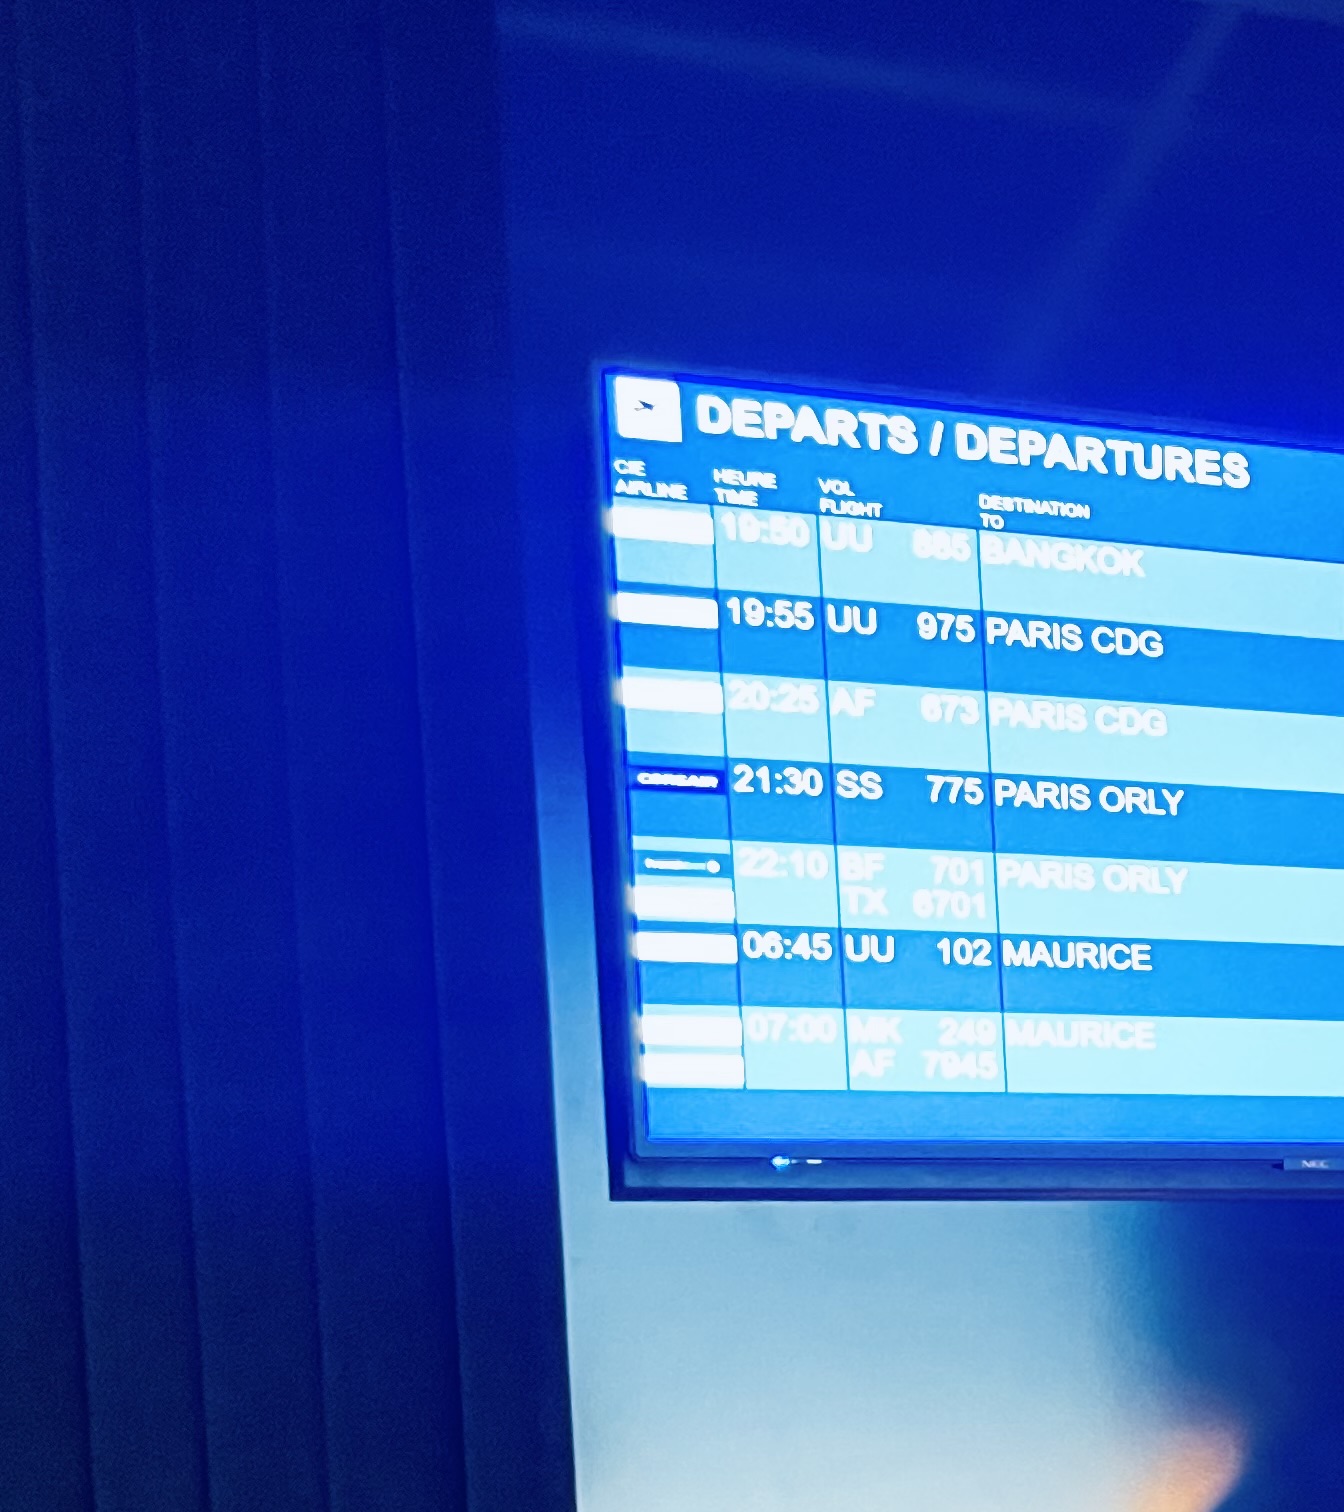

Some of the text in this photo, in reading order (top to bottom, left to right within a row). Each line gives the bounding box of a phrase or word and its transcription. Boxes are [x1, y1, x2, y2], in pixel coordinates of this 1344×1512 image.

[696, 394, 1250, 488] DEPARTS / DEPARTURES
[818, 478, 855, 496] VOL
[979, 494, 1091, 519] DESTINATION
[819, 498, 883, 517] FLIGHT
[979, 513, 1005, 530] TO
[823, 522, 873, 552] UU
[982, 536, 1146, 577] BANGKOK
[727, 598, 815, 630] 19:55
[827, 604, 877, 635] UU
[917, 612, 976, 642] 975
[986, 617, 1083, 651] PARIS
[1091, 626, 1164, 657] CDG
[729, 680, 819, 713] 20:25
[831, 688, 876, 716] AF
[990, 698, 1087, 731] PARIS
[1095, 706, 1167, 736] CDG
[733, 764, 823, 796] 21:30
[837, 769, 883, 799] SS
[927, 775, 984, 805] 775
[995, 779, 1091, 810] PARIS
[1099, 786, 1184, 816] ORLY
[738, 848, 828, 878] 22:10
[840, 852, 884, 880] BF
[932, 856, 983, 885] 701
[998, 859, 1094, 890] PARIS
[1103, 865, 1187, 893] ORLY
[841, 886, 888, 914] TX
[743, 931, 833, 961] 06:45
[845, 934, 894, 962] UU
[937, 938, 992, 966] 102
[1003, 940, 1153, 970] MAURICE
[747, 1013, 836, 1042] 07:00
[849, 1016, 901, 1042] MK
[940, 1018, 996, 1045] 249
[1006, 1020, 1154, 1048] MAURICE
[851, 1049, 895, 1076] AF
